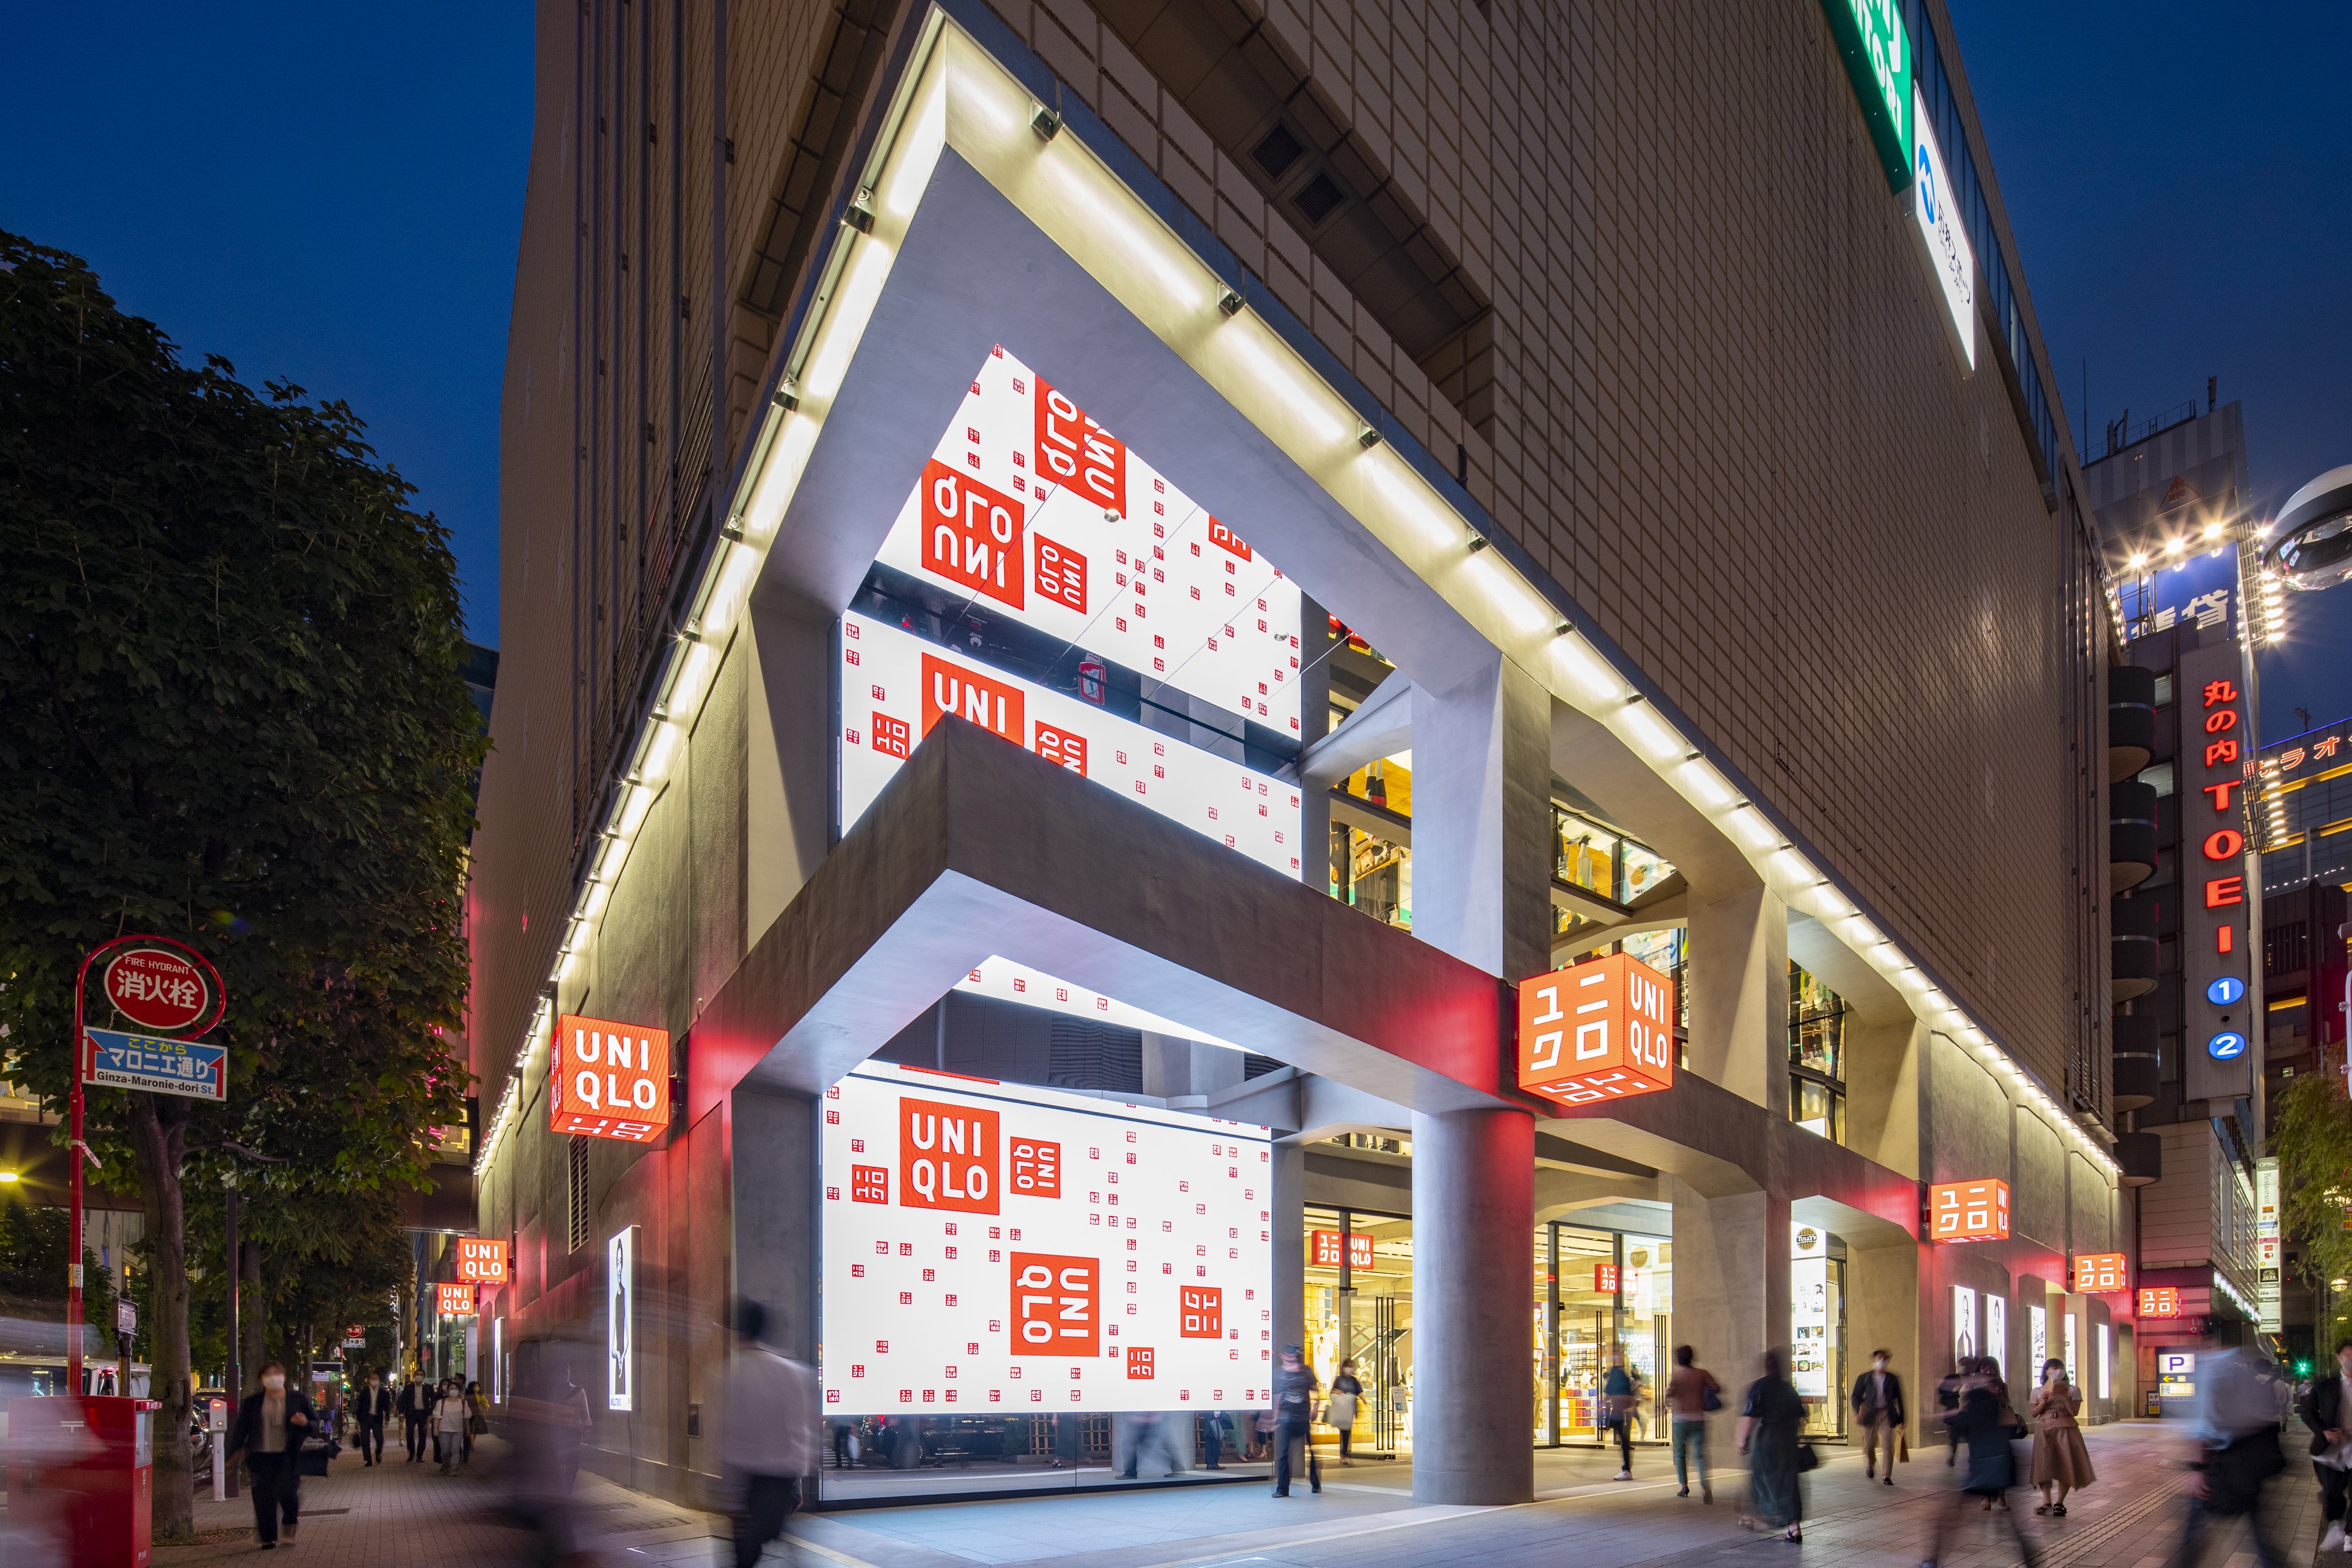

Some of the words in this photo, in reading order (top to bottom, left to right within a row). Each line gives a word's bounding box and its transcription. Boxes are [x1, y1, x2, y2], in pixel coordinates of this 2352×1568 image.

[1848, 0, 1902, 141] ITORI
[934, 671, 1005, 734] UNI
[2204, 680, 2238, 767] 丸の内
[1039, 730, 1059, 758] QL
[1063, 738, 1081, 773] UN
[2259, 735, 2352, 779] ラオ
[2203, 779, 2243, 954] TOEI
[125, 956, 145, 967] FIRE
[149, 961, 189, 975] HYDRANT
[117, 969, 198, 1009] 消火栓
[1533, 973, 1608, 1026] ユニ
[1630, 971, 1664, 1025] UNI
[129, 1037, 187, 1055] ここから
[576, 1029, 649, 1071] UNI
[1530, 1019, 1608, 1071] クロ
[1630, 1020, 1668, 1069] QLO
[109, 1047, 208, 1079] マロニエ通り
[96, 1071, 199, 1093] Ginza-Maronie-dori
[200, 1085, 215, 1095] St.
[576, 1070, 656, 1110] QLO
[912, 1113, 981, 1157] UNI
[1013, 1144, 1034, 1188] QLO
[1038, 1147, 1055, 1188] UNI
[912, 1159, 988, 1202] QLO
[1940, 1187, 1988, 1209] ユニ
[1938, 1210, 1987, 1232] クロ
[465, 1244, 498, 1260] UNI
[1320, 1234, 1339, 1248] ユニ
[1351, 1237, 1370, 1252] UNI
[465, 1261, 502, 1277] QLO
[1319, 1249, 1340, 1263] クロ
[1351, 1252, 1371, 1267] QLO
[2080, 1258, 2114, 1272] ユニ
[1601, 1279, 1616, 1290] クロ
[1602, 1267, 1616, 1279] ユニ
[2079, 1273, 2114, 1287] クロ
[443, 1287, 467, 1299] UNI
[443, 1299, 470, 1312] QLO
[1016, 1265, 1053, 1343] QLO
[1059, 1268, 1089, 1337] UNI
[2144, 1291, 2170, 1302] ユニ
[2143, 1302, 2171, 1313] クロ
[2169, 1357, 2184, 1371] P
